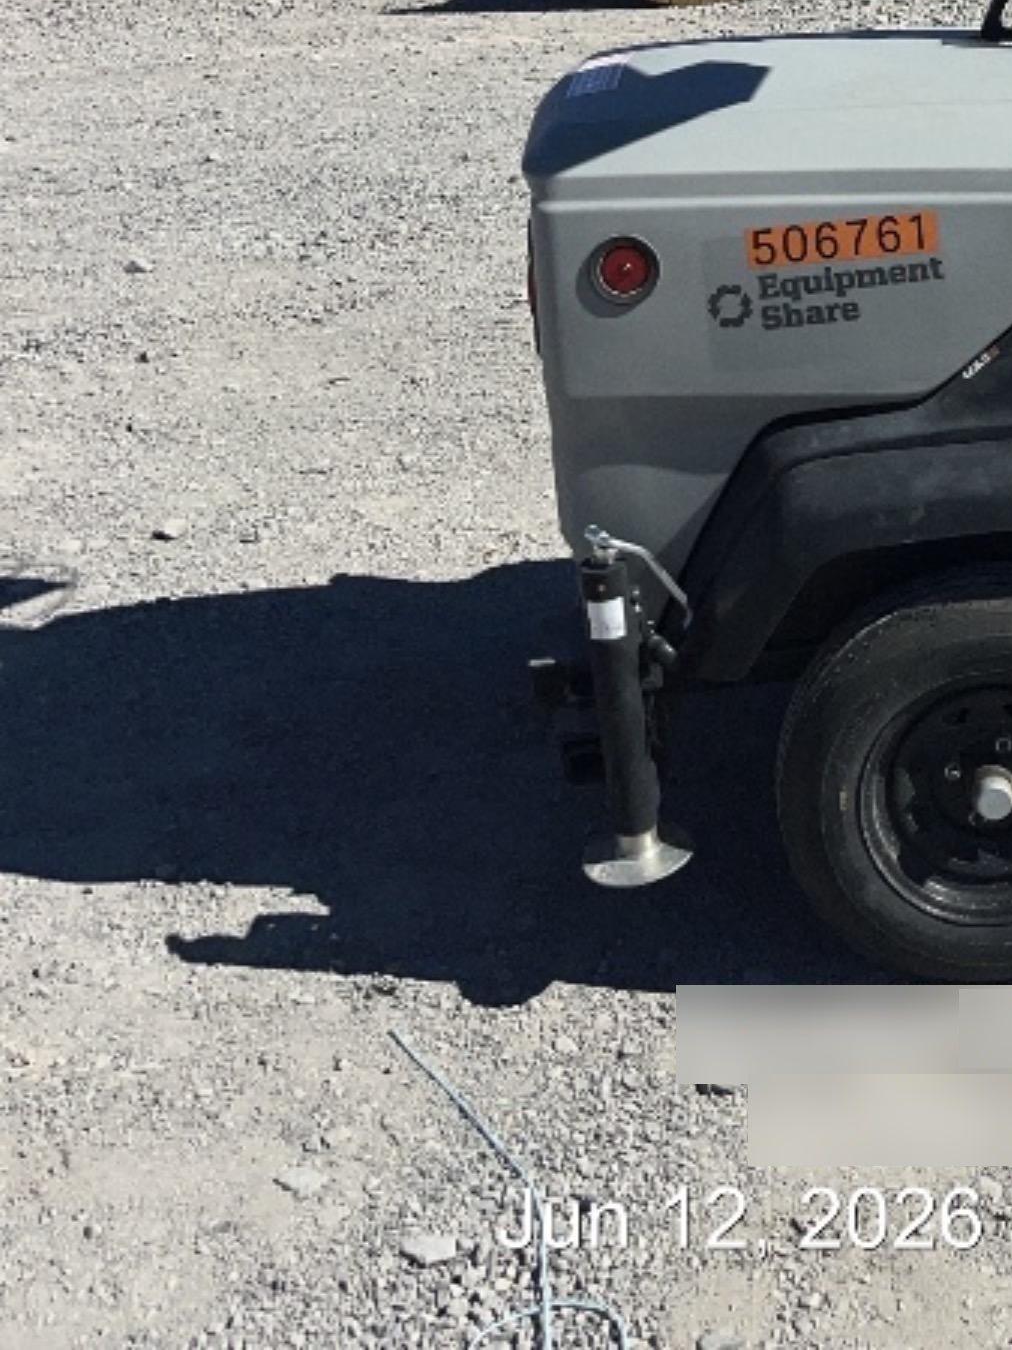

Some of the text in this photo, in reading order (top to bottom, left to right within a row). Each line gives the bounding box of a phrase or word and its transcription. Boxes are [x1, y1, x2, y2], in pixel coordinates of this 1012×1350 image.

[751, 213, 925, 266] 506761
[757, 257, 945, 301] Equipment
[760, 301, 861, 331] Share
